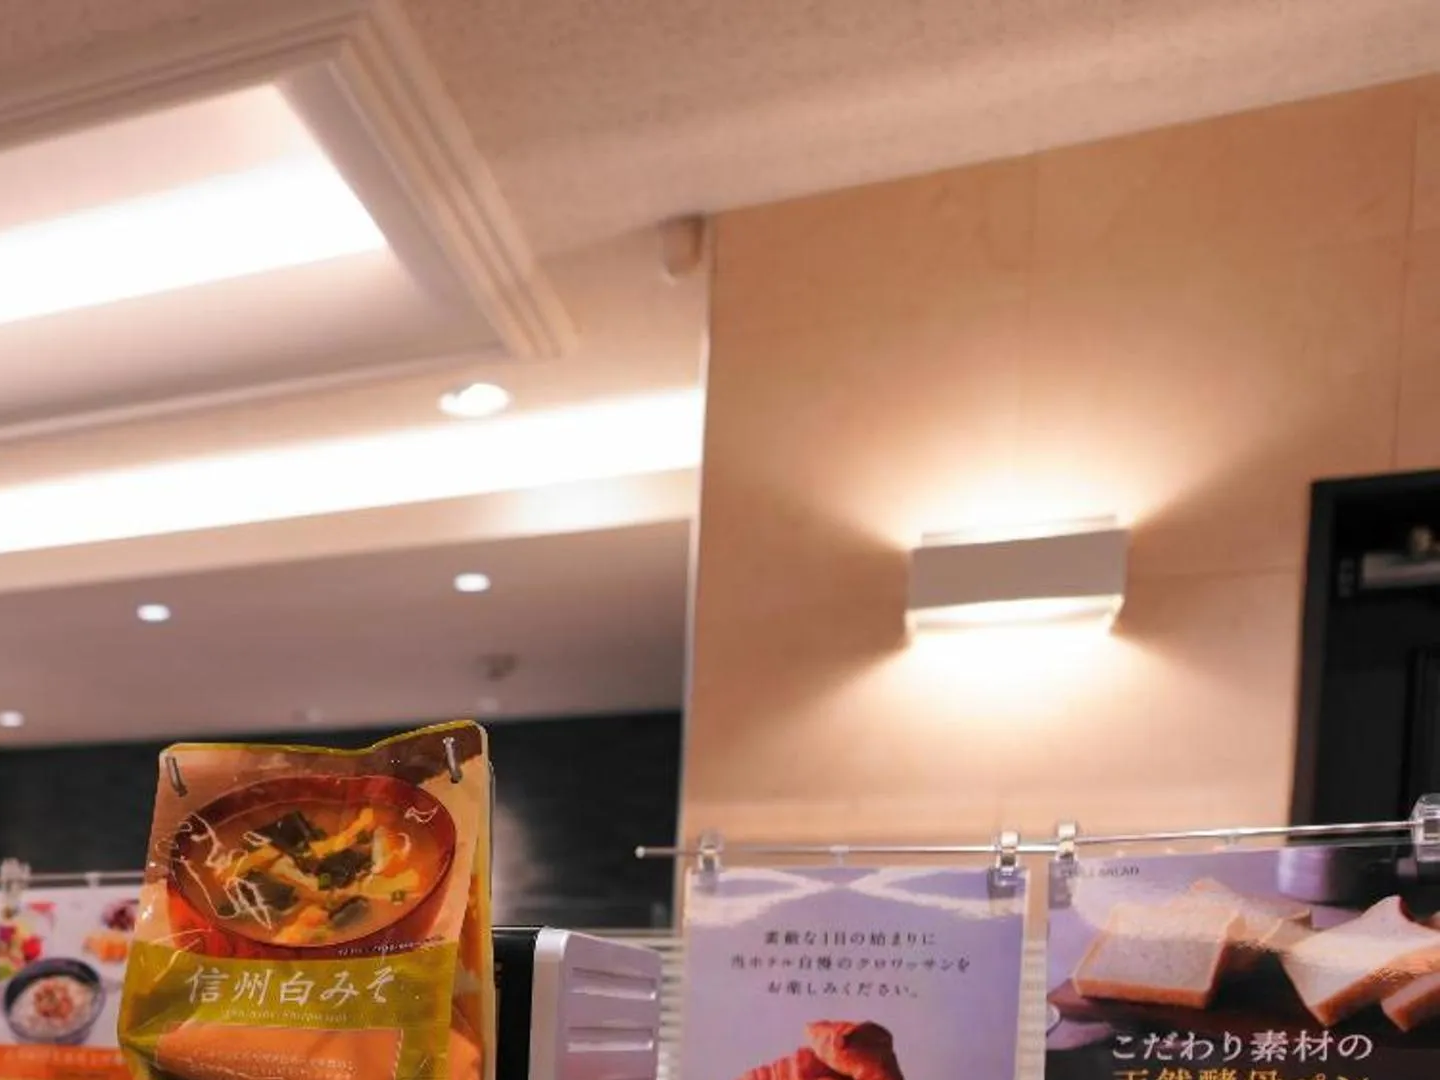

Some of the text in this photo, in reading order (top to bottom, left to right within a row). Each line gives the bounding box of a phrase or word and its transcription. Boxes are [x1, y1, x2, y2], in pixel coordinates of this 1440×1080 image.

[184, 965, 396, 1005] 信州白みそ
[1112, 1030, 1374, 1062] こだわり素材の
